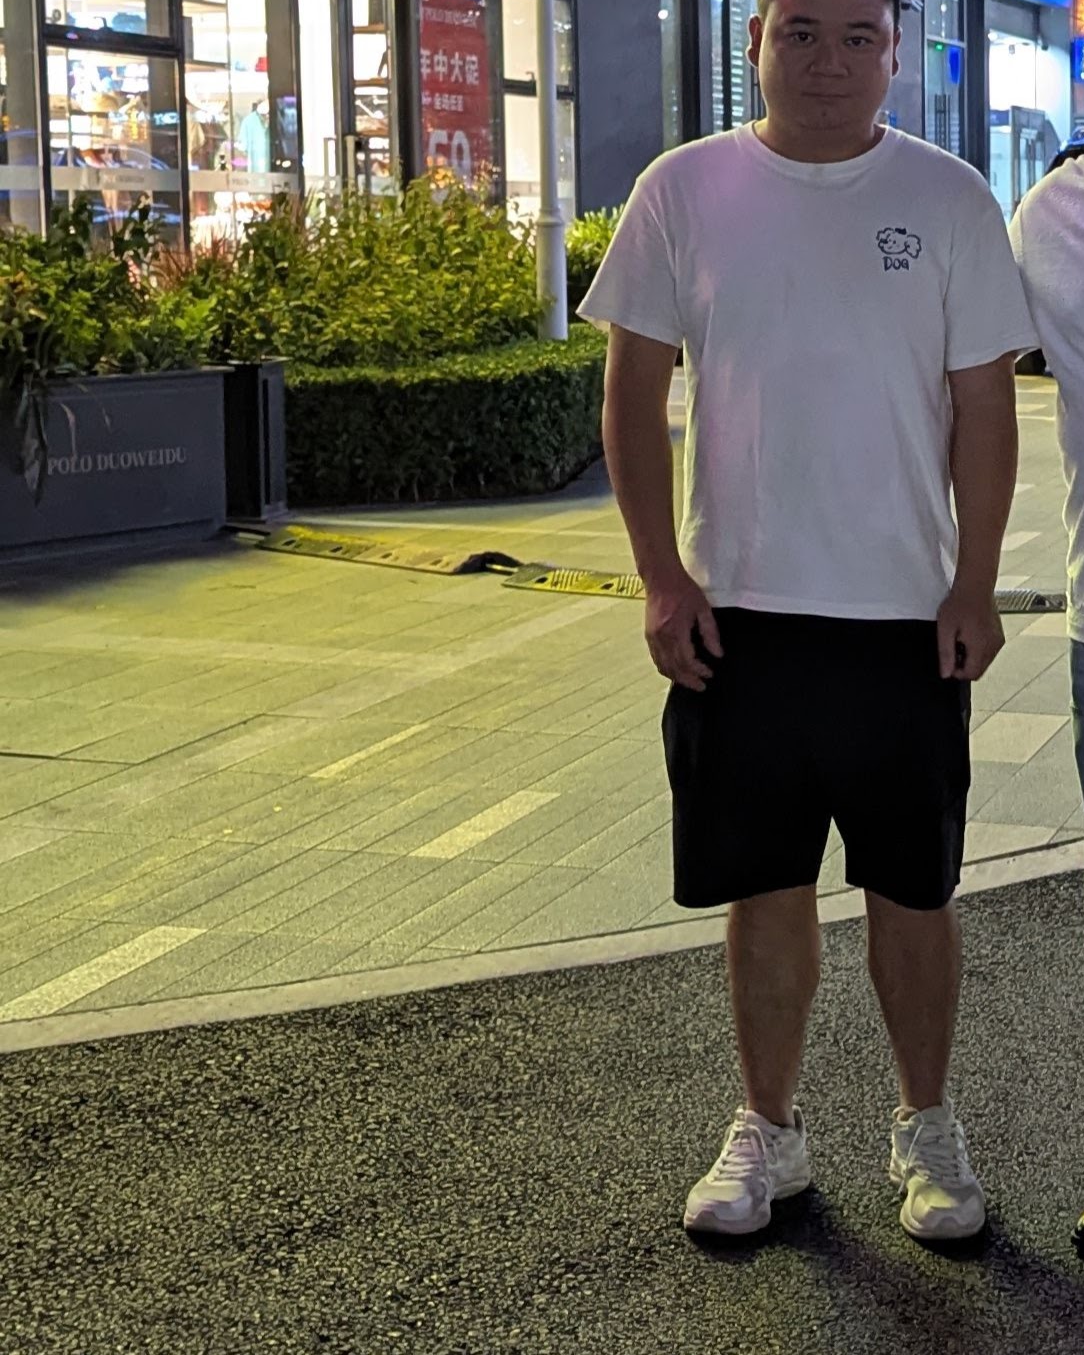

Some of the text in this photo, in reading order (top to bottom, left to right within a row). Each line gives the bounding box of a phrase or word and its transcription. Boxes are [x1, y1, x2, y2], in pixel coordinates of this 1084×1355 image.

[882, 256, 909, 272] DOG
[47, 446, 187, 476] POLO DUOWEIDU
